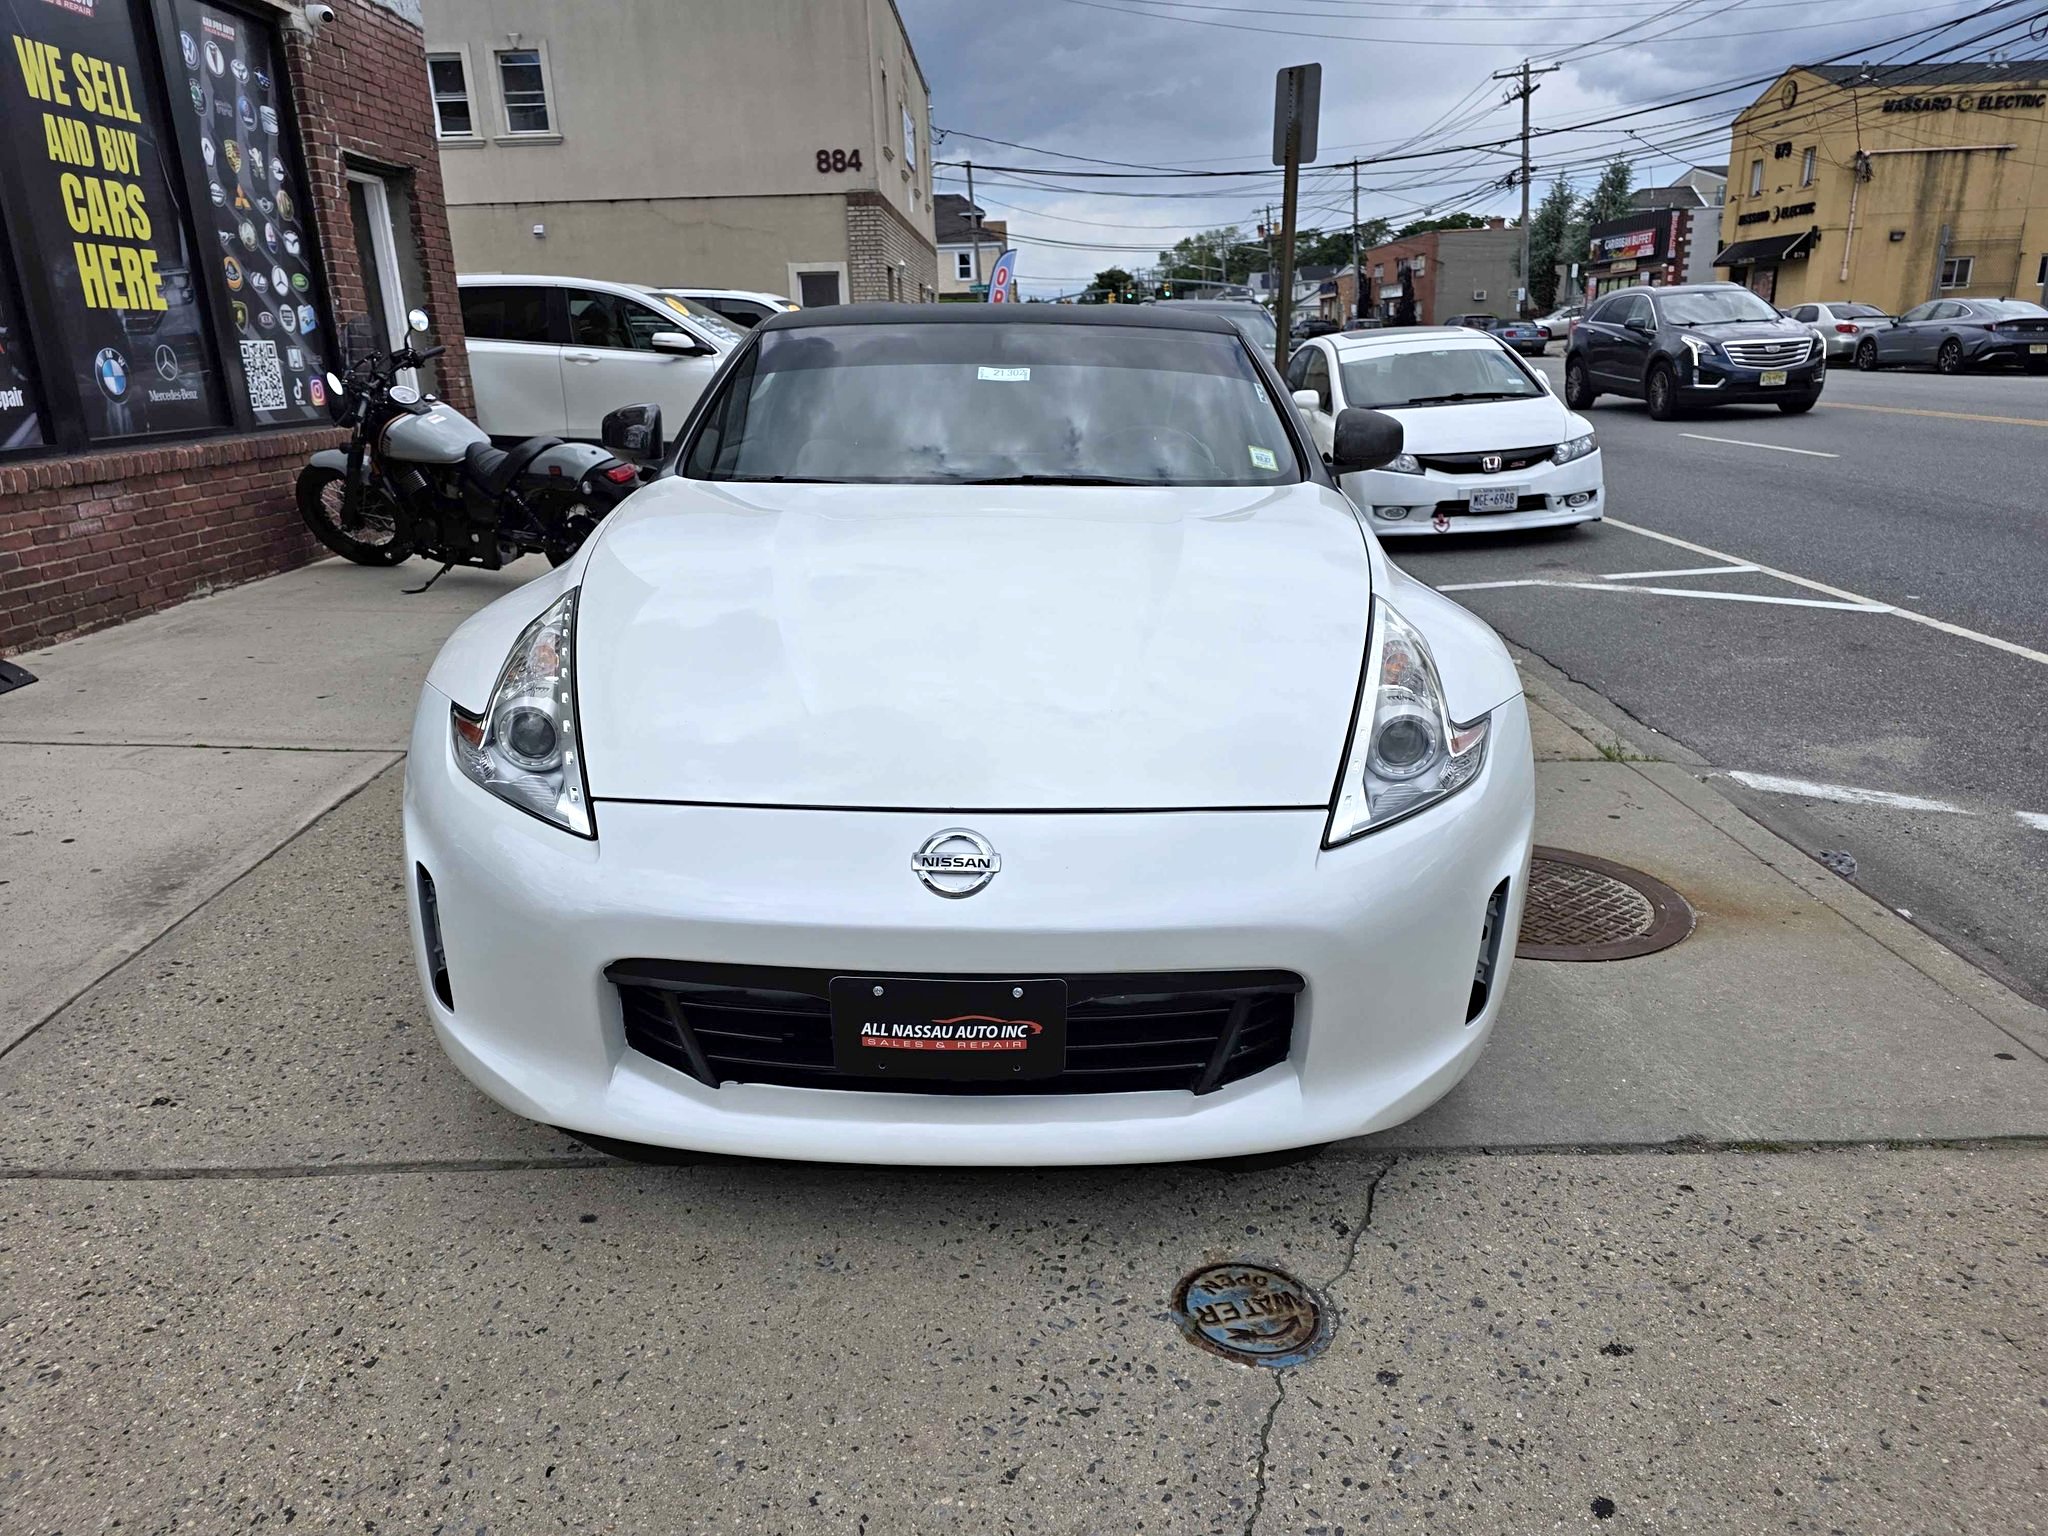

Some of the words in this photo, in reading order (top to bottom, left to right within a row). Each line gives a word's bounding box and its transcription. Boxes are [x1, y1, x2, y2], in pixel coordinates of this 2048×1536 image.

[64, 0, 92, 16] REPAIR
[12, 34, 72, 106] WE
[71, 52, 142, 124] SELL
[1882, 98, 1952, 113] MASSARO
[1977, 94, 2047, 110] ELECTRIC
[42, 112, 95, 168] AND
[95, 125, 141, 177] BUY
[816, 149, 863, 174] 884
[60, 172, 152, 241] CARS
[1632, 232, 1653, 246] BUFFET
[73, 242, 169, 311] HERE
[148, 388, 199, 402] Mercedes-Benz
[922, 857, 991, 868] NISSAN
[861, 1023, 888, 1037] ALL
[892, 1024, 953, 1039] NASSAU
[955, 1025, 998, 1039] AUTO
[1000, 1024, 1028, 1039] INC
[867, 1038, 924, 1048] SALES
[957, 1041, 1022, 1049] REPAIR
[1200, 1273, 1268, 1295] OPEN
[1194, 1291, 1304, 1325] WATER
